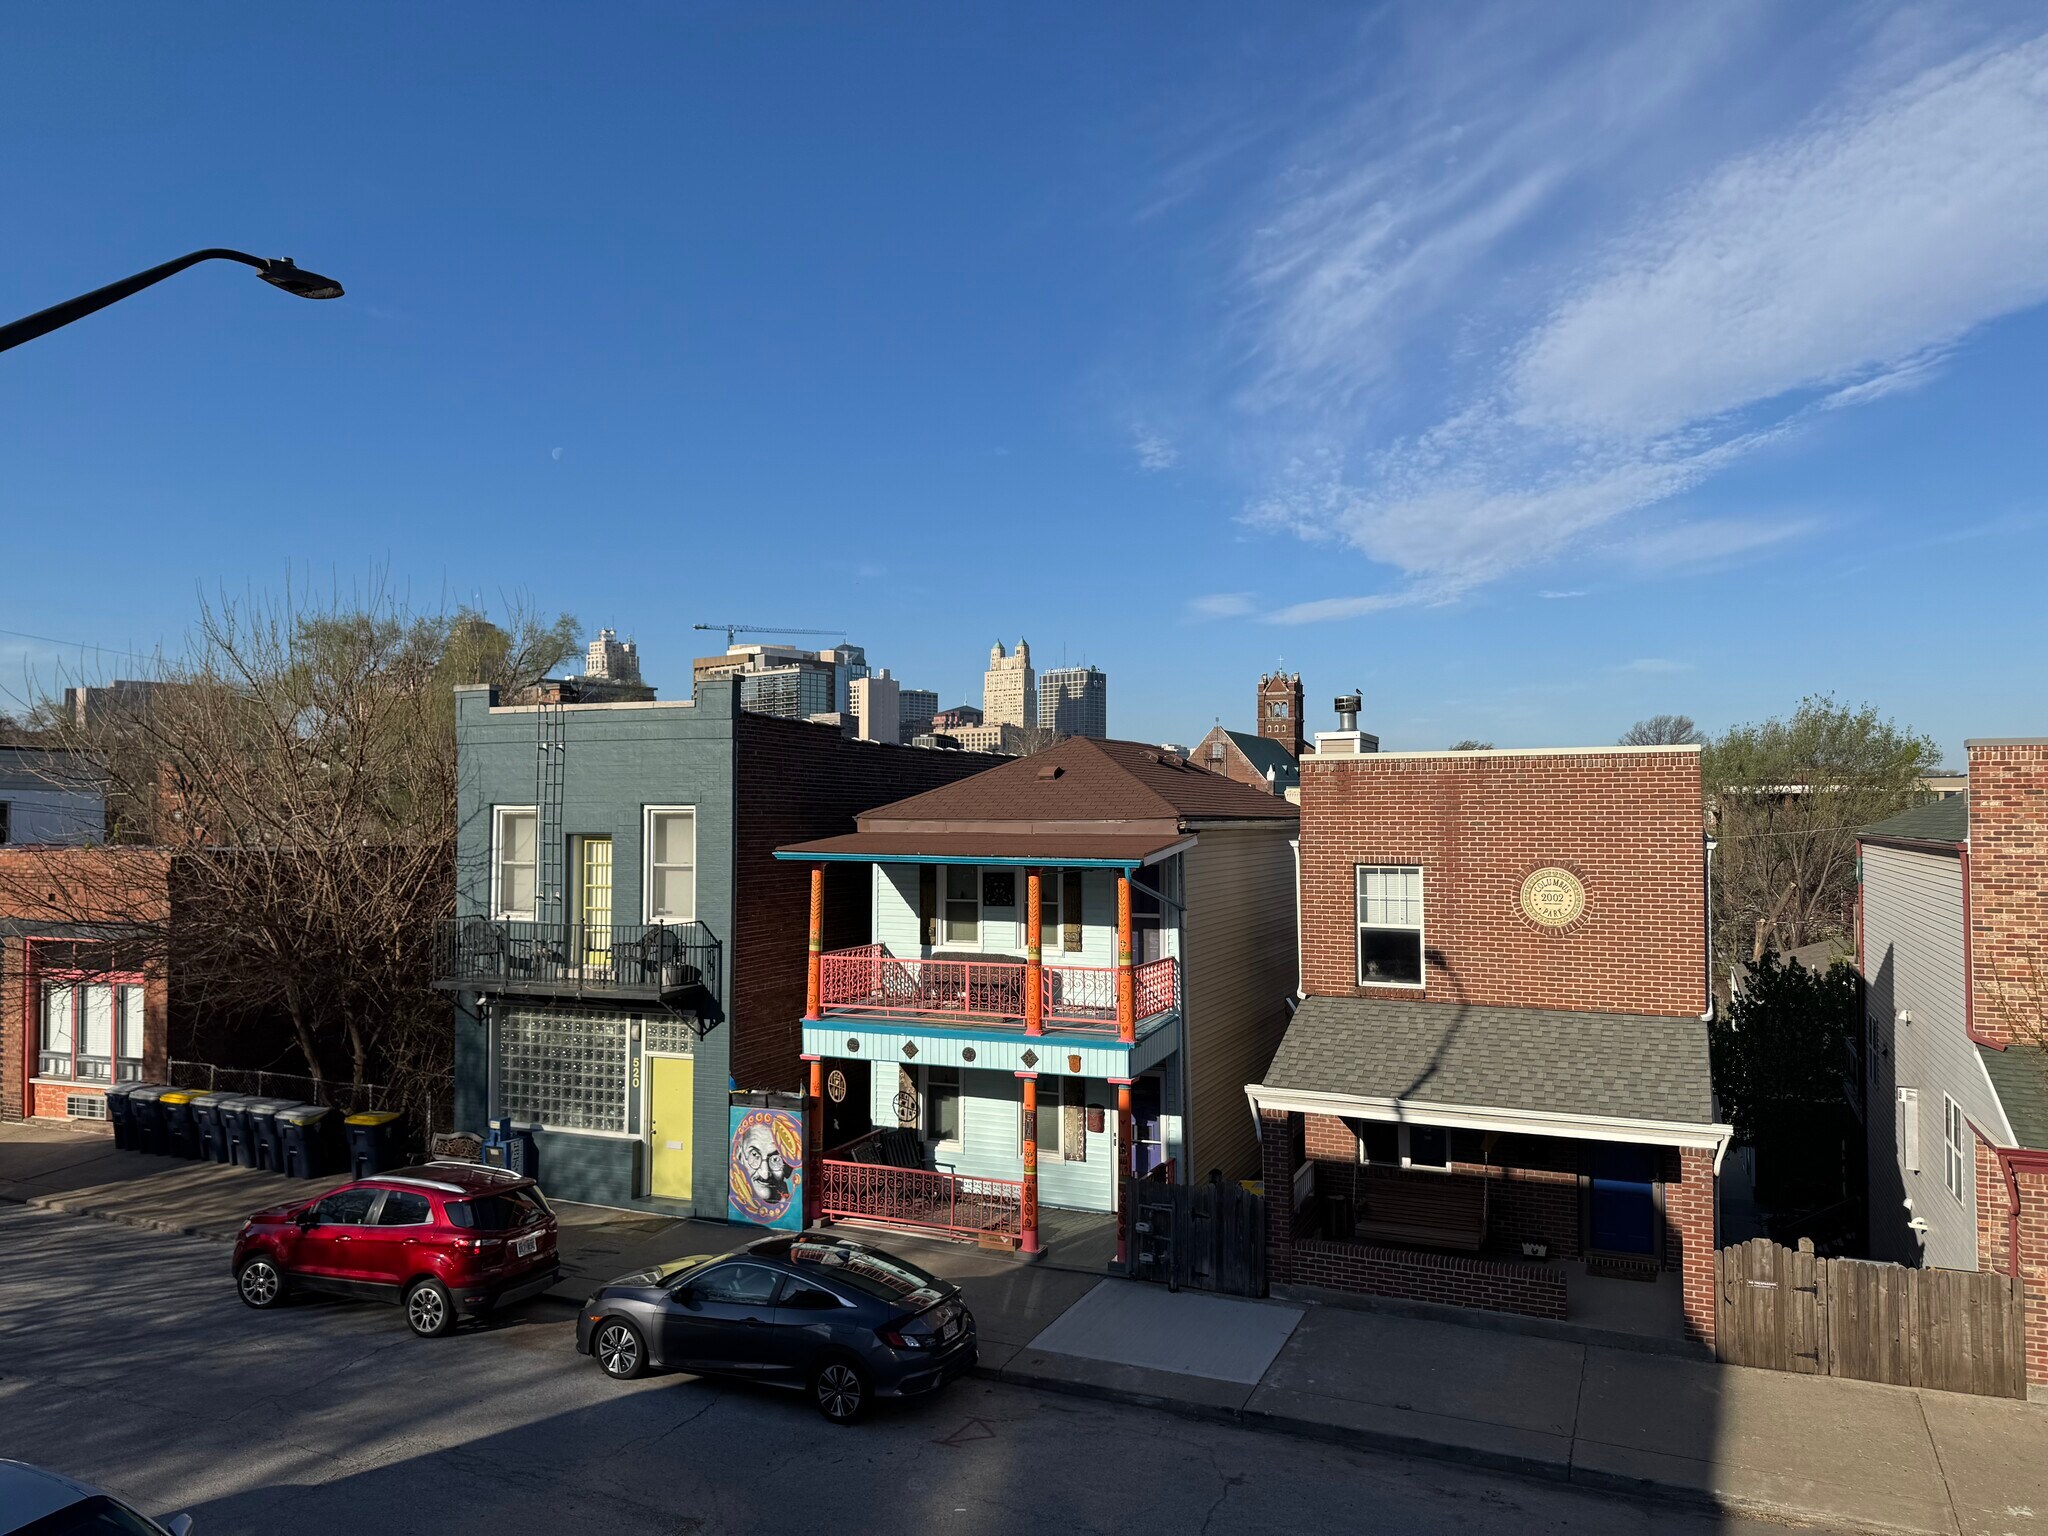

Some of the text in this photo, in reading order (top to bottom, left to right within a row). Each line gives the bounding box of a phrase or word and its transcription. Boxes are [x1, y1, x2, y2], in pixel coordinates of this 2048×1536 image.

[1534, 878, 1571, 894] COLUMBUS
[1541, 893, 1564, 902] 2002
[1542, 907, 1564, 917] PARK
[632, 1057, 640, 1088] 520
